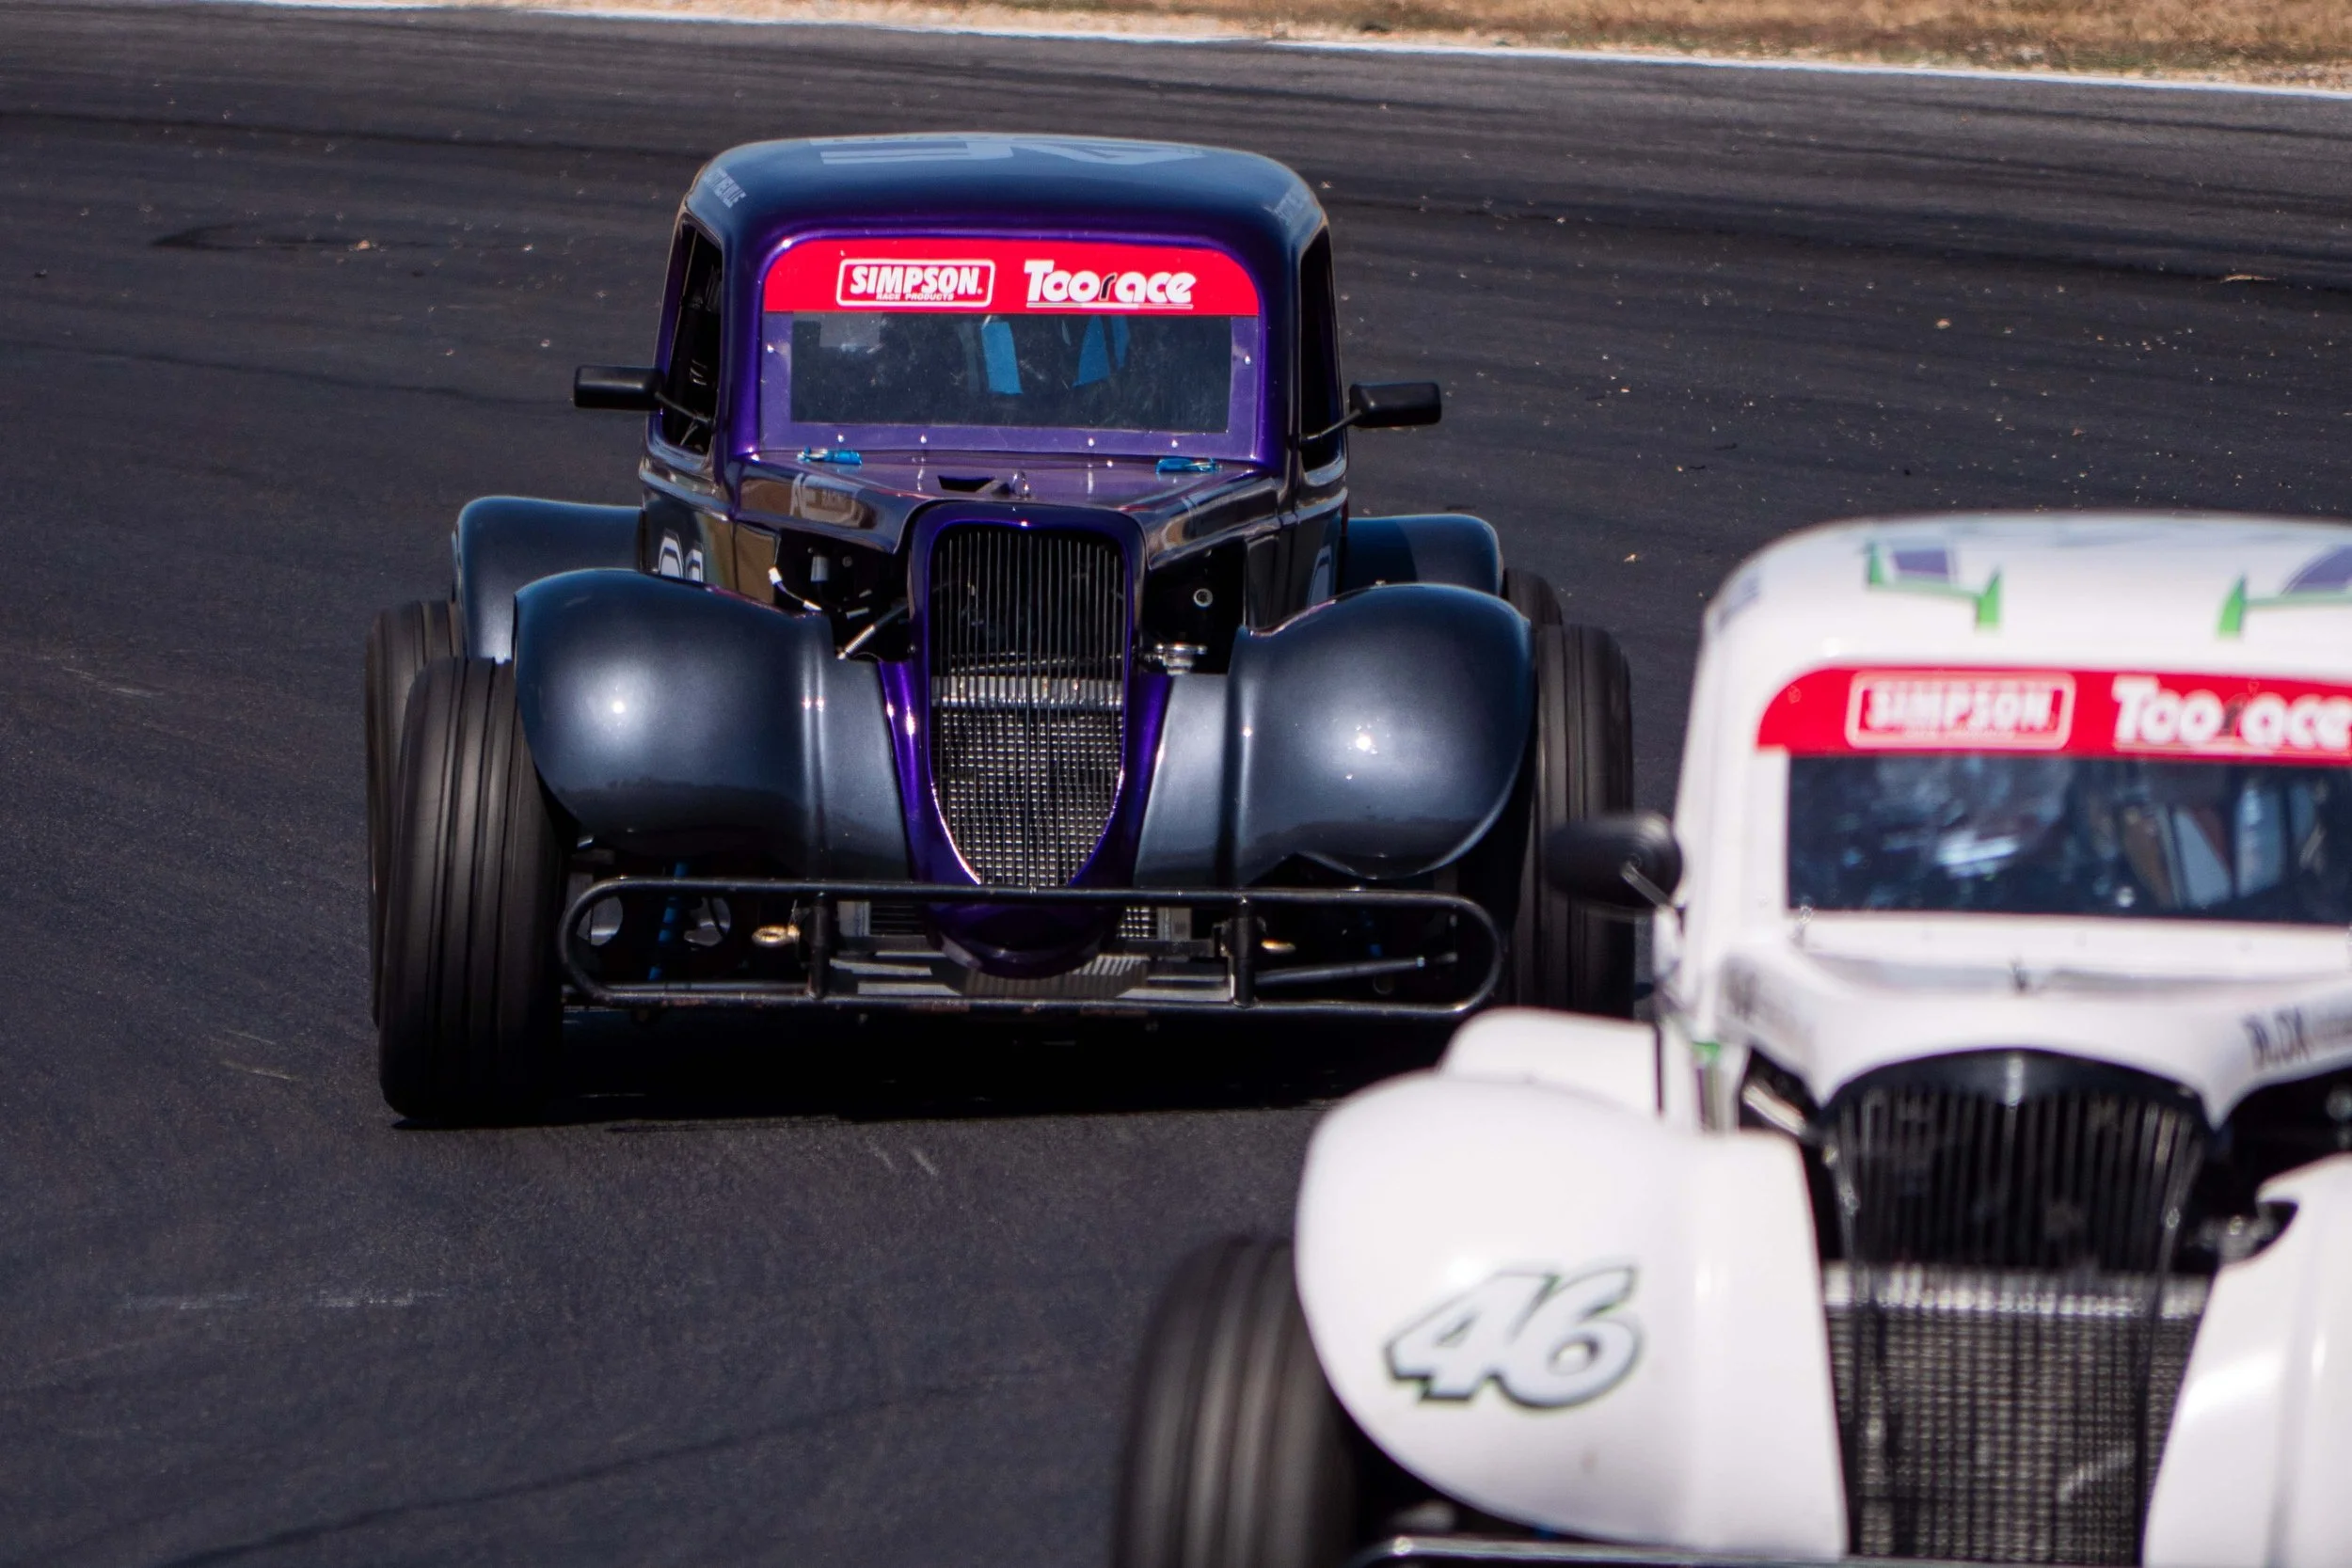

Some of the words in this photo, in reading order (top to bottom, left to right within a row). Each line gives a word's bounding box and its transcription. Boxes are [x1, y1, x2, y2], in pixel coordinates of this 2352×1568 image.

[904, 293, 955, 302] PRODUCTS
[1024, 259, 1197, 304] Toorace
[1383, 1264, 1645, 1412] 46
